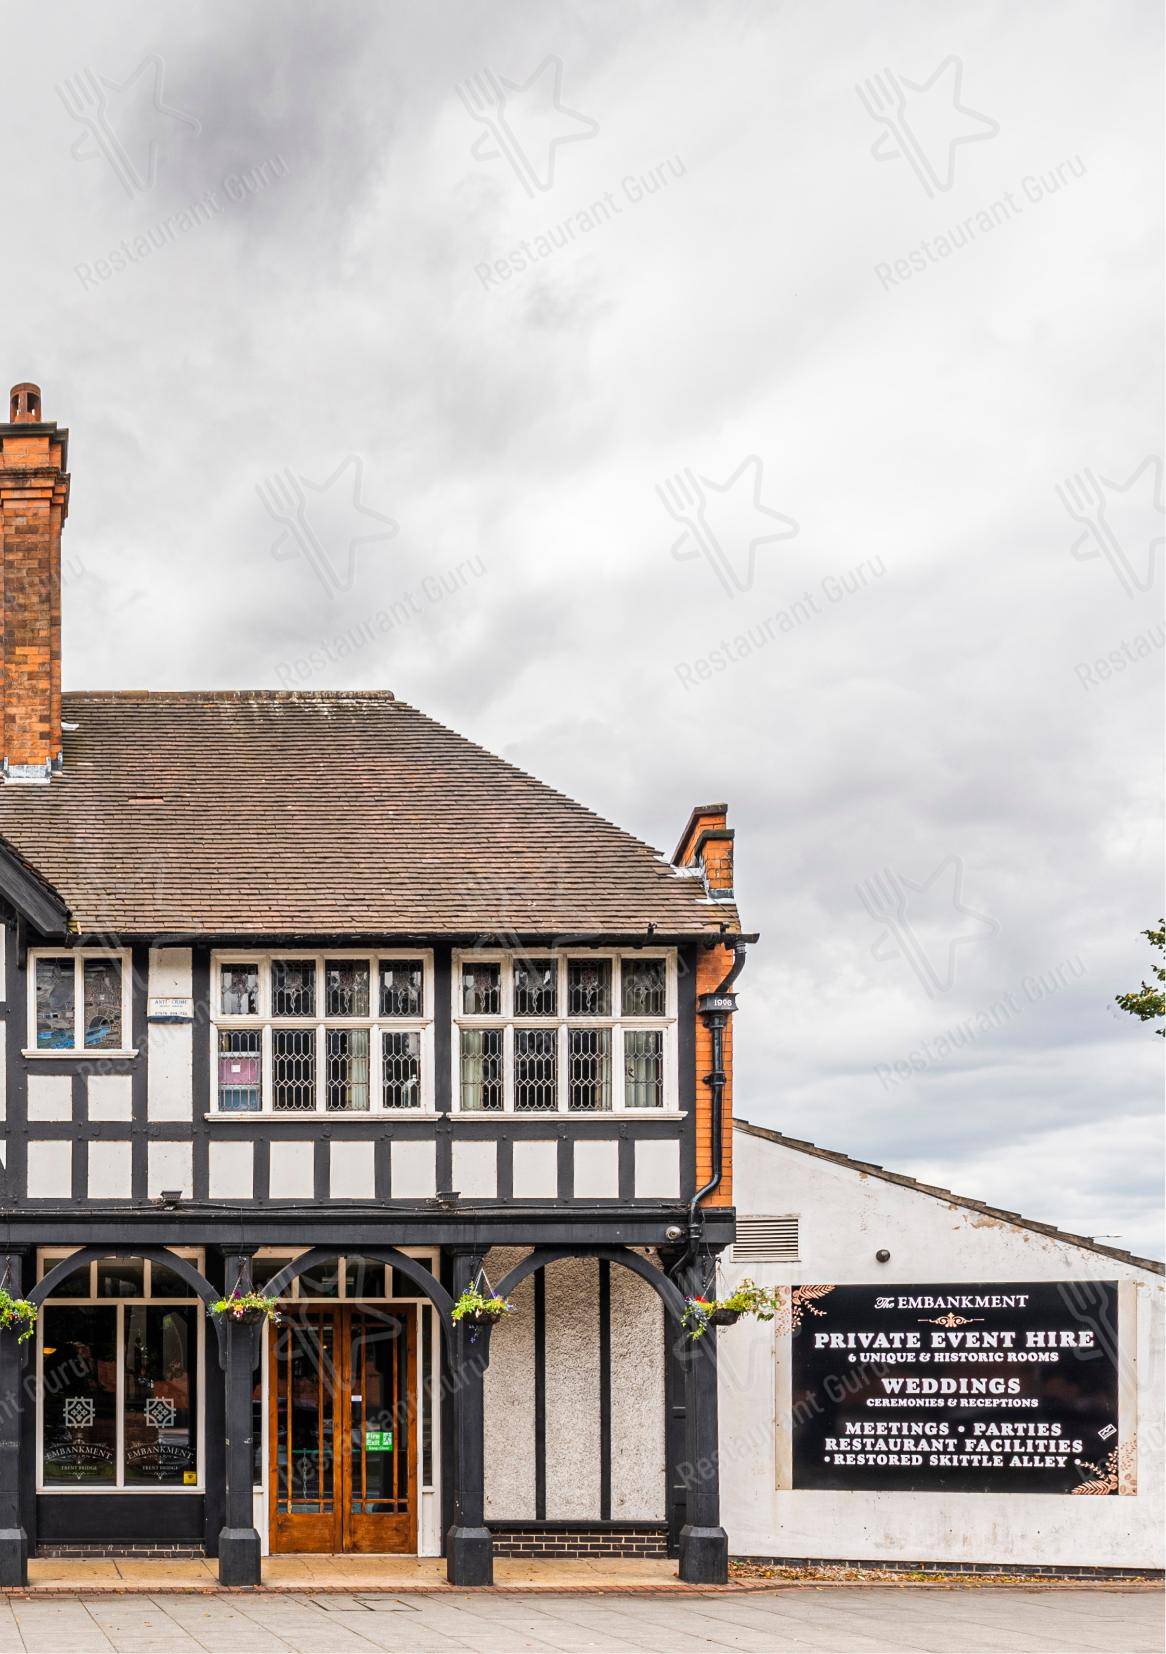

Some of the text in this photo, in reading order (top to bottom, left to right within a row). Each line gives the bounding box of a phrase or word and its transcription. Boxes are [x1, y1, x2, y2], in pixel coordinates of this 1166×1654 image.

[874, 1295, 1029, 1309] The EMBANKMENT
[814, 1331, 1095, 1349] PRIVATE EVENT HIRE
[859, 1352, 916, 1364] UNIQUE
[919, 1352, 931, 1362] &
[934, 1352, 1004, 1362] HISTORIC
[1007, 1352, 1059, 1362] ROOMS
[881, 1378, 1021, 1394] WEDDINGS
[866, 1398, 1039, 1408] CEREMONIES & RECEPTIONS
[845, 1422, 1062, 1437] MEETINGS PARTIES
[825, 1438, 1083, 1453] RESTAURANT FACILITIES
[46, 1446, 113, 1460] EMBANKMENT
[127, 1446, 192, 1460] EMBANKMENT
[834, 1454, 1068, 1468] RESTORED SKITTLE ALLEY
